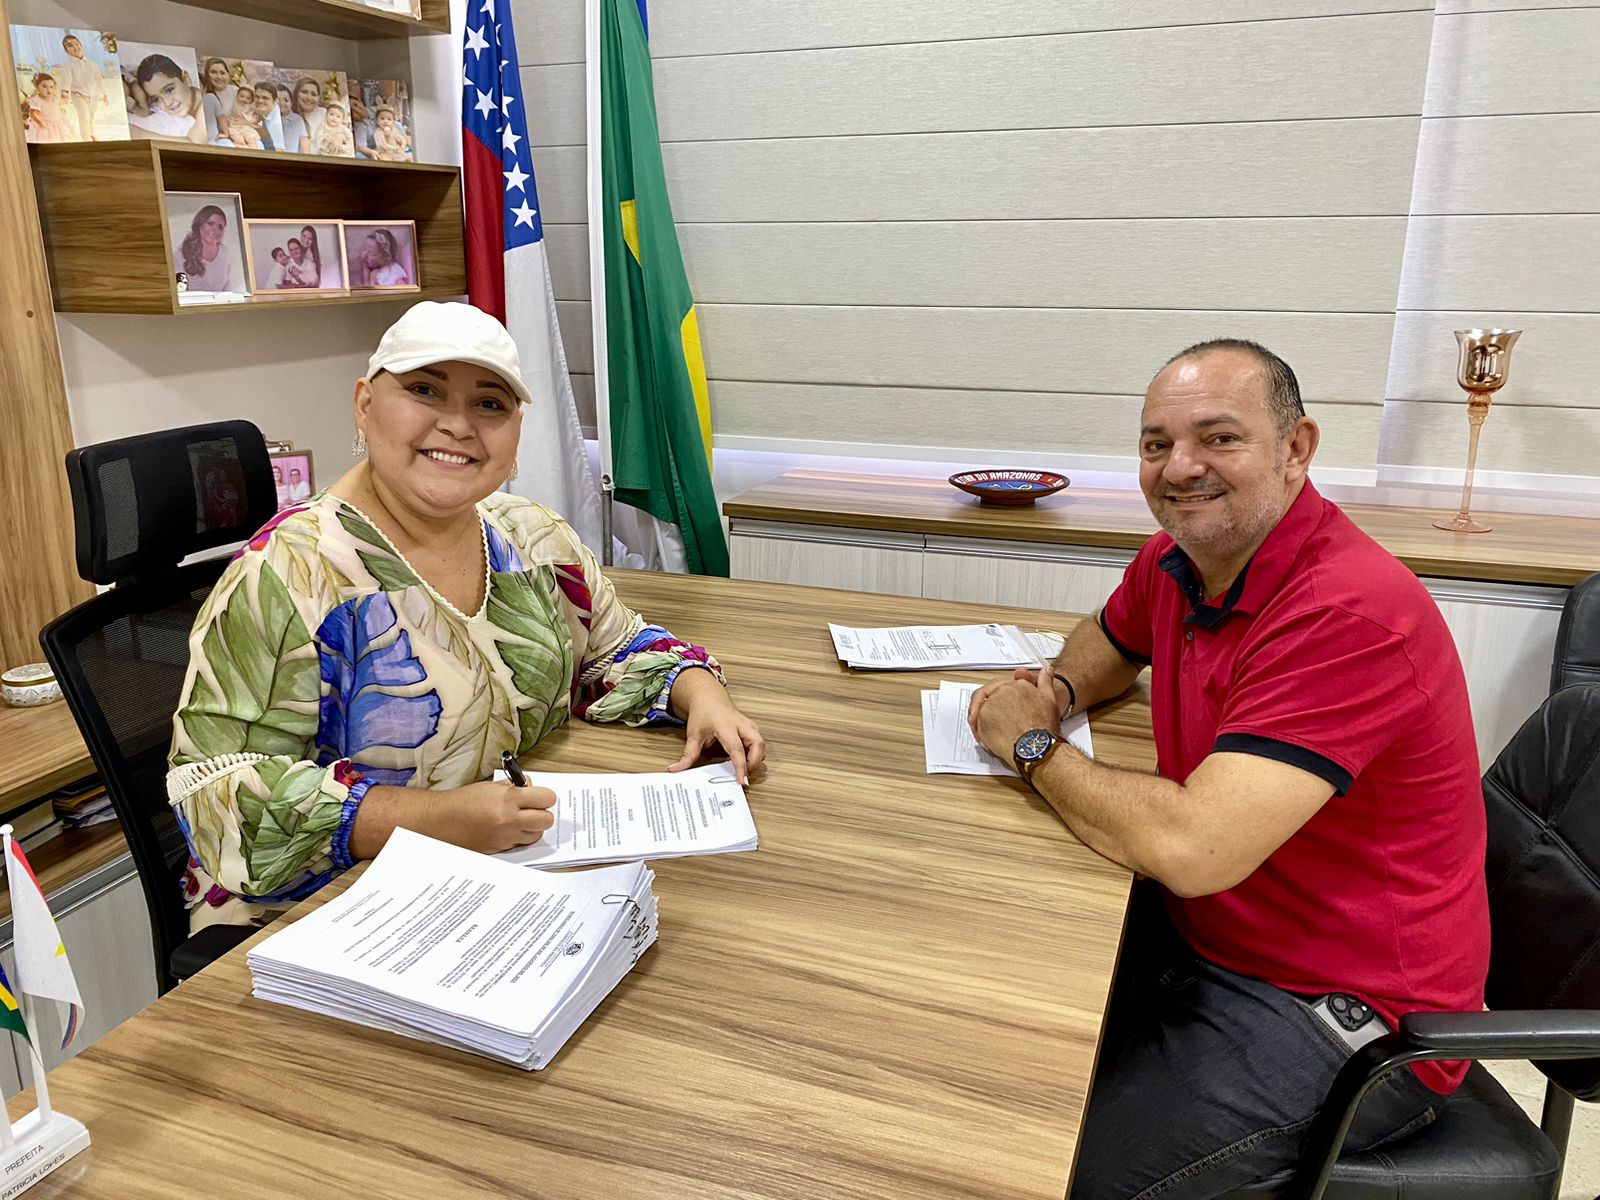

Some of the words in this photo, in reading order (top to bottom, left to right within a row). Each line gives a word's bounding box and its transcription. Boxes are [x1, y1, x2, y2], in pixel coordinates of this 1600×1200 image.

[975, 473, 988, 481] DO
[989, 471, 1042, 481] AMAZONAS
[4, 1144, 45, 1175] PREFEITA
[1, 1172, 38, 1200] PATRICIA
[39, 1153, 66, 1175] LOPES
